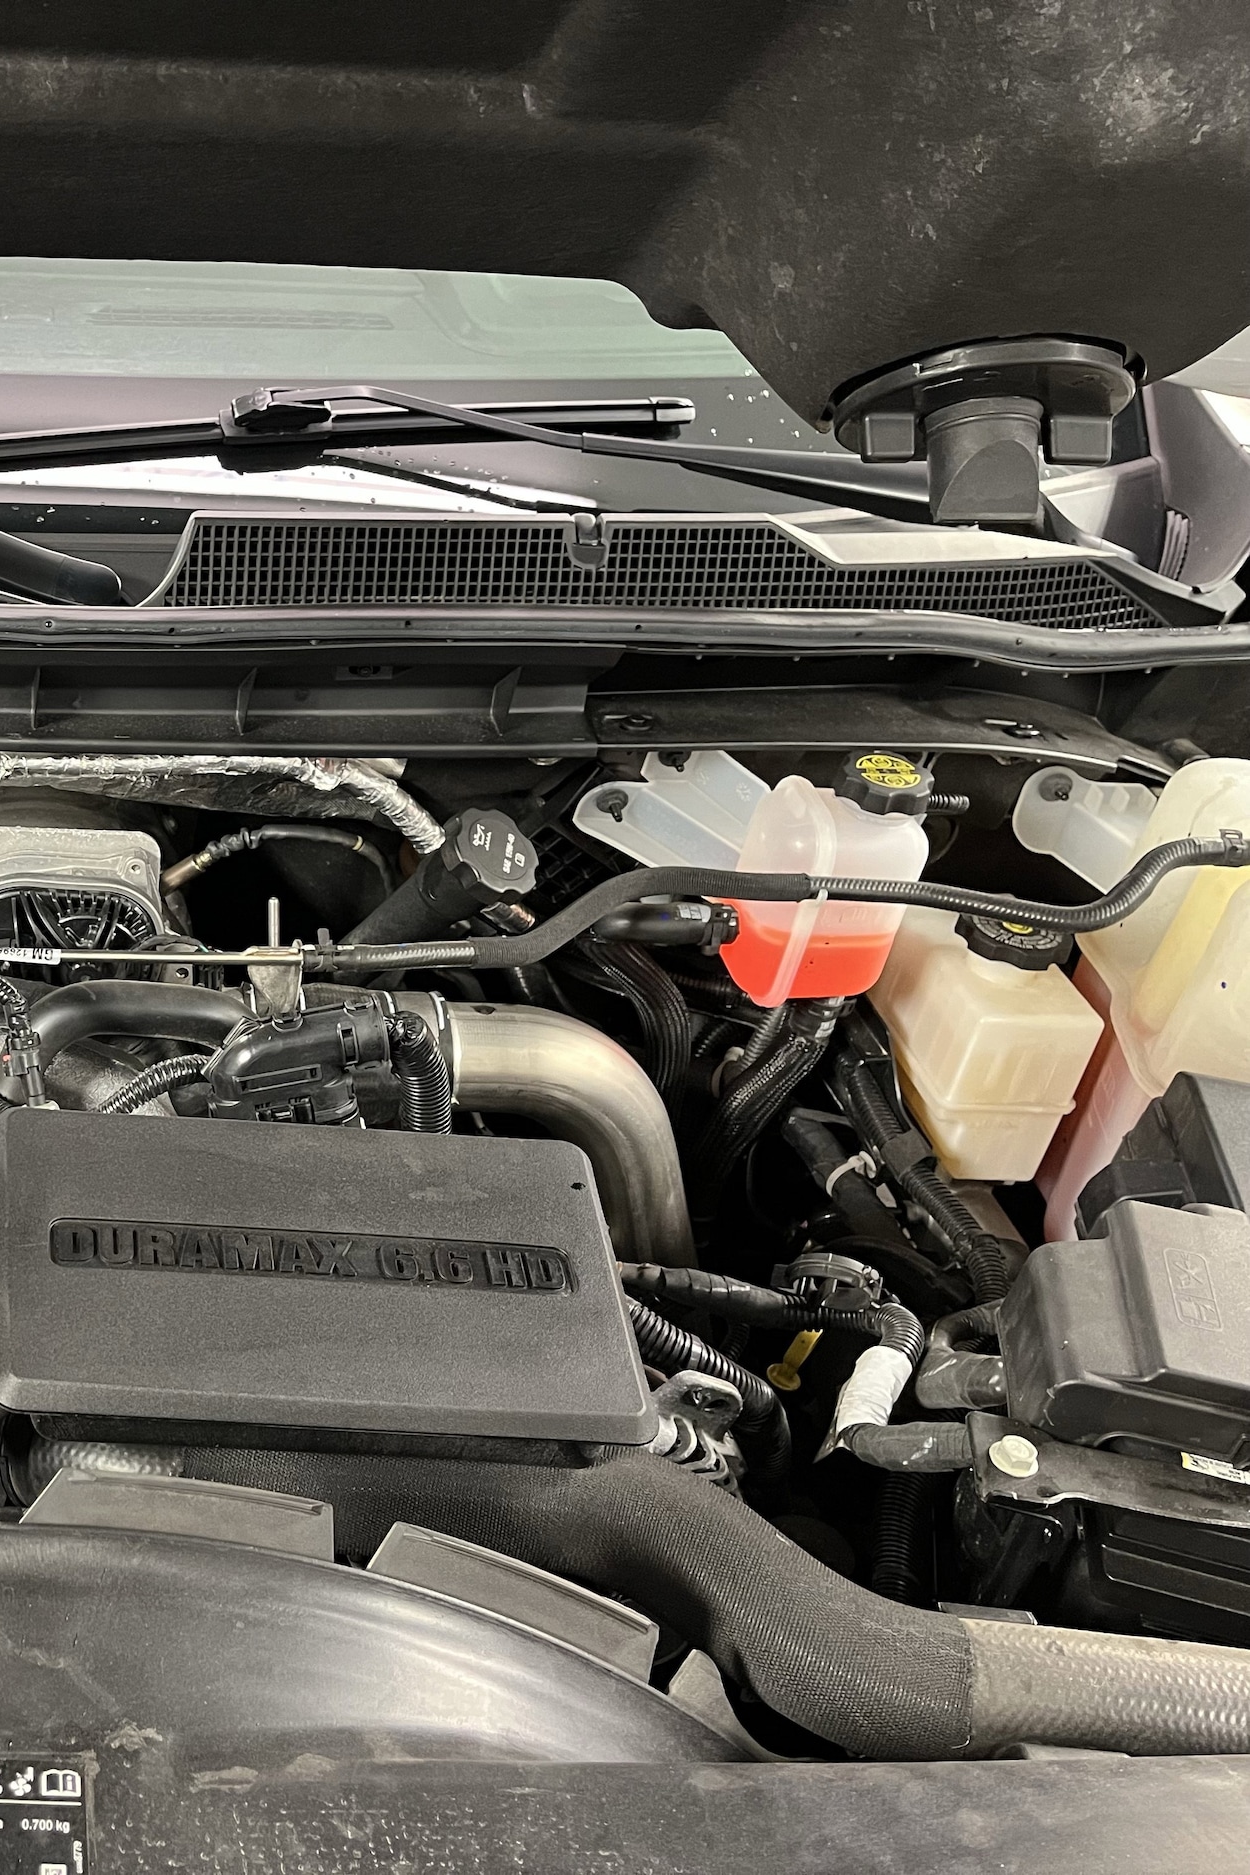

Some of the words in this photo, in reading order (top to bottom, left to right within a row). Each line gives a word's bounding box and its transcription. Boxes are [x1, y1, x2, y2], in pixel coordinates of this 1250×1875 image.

[32, 948, 54, 961] GM
[62, 1224, 357, 1277] DURAMAX
[377, 1241, 474, 1285] 6.6
[485, 1247, 569, 1291] HD
[21, 1818, 54, 1831] 0.700
[55, 1819, 71, 1833] kg
